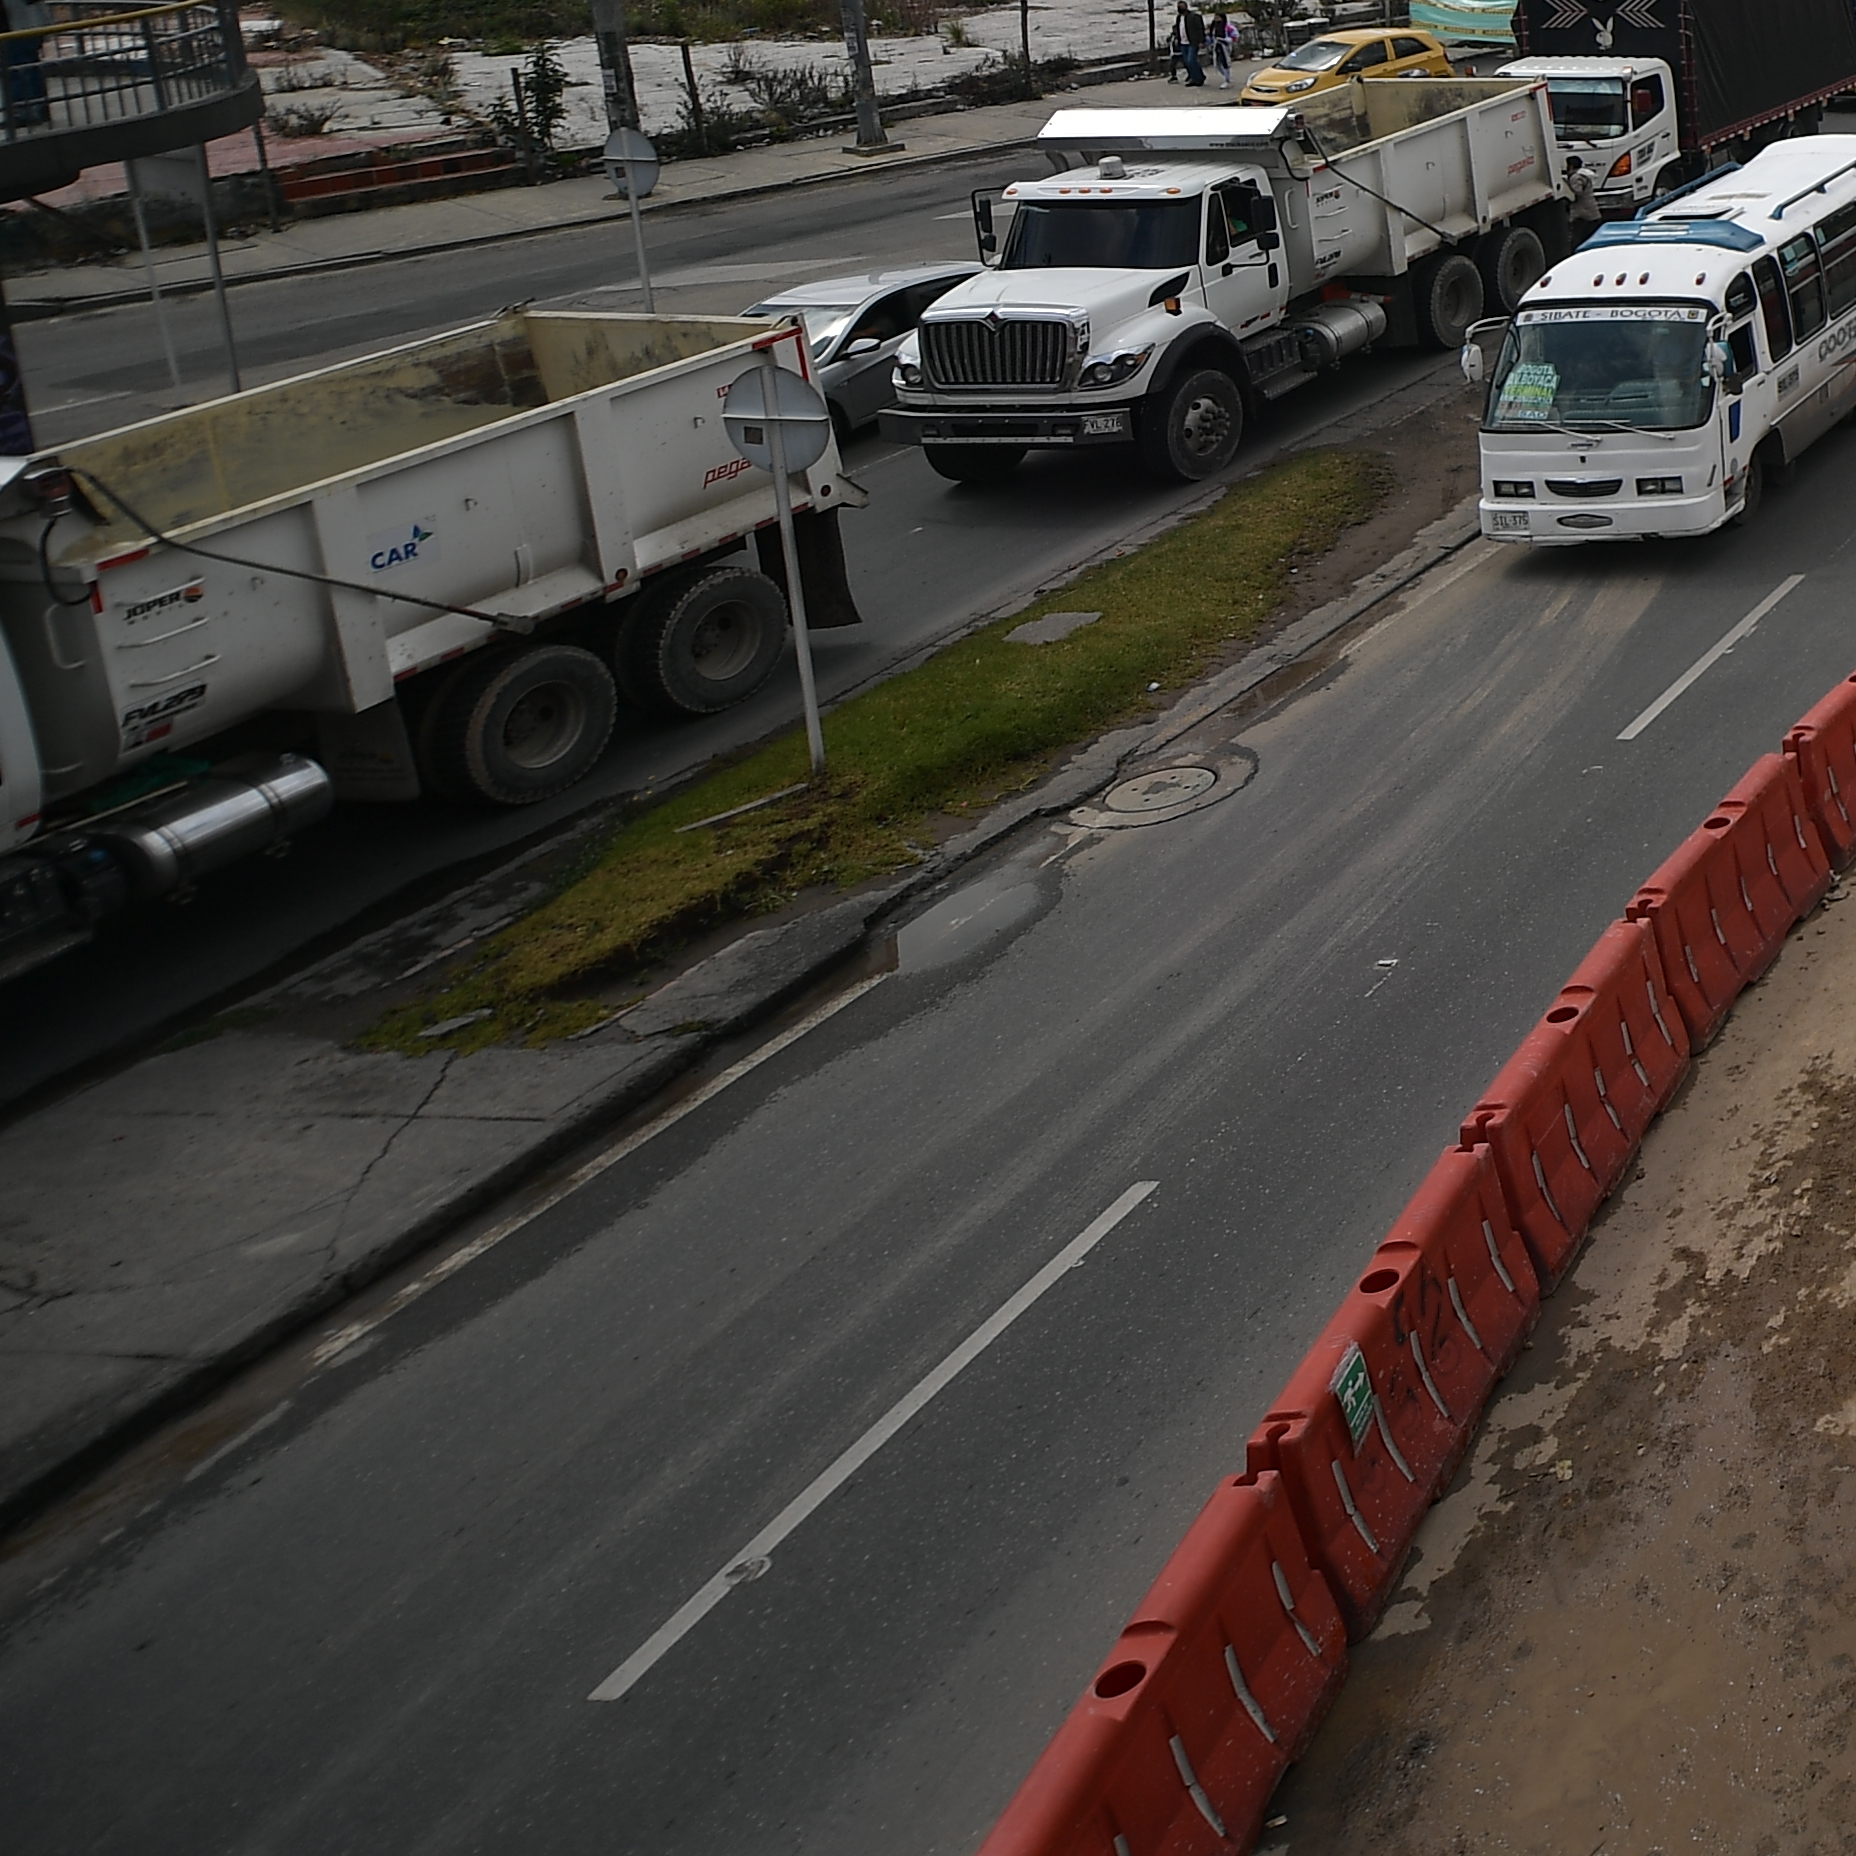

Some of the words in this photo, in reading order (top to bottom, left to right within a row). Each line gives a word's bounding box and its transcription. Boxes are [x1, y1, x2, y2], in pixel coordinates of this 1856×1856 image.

[1540, 309, 1591, 322] SIBATE
[1610, 308, 1684, 320] BOGOTA
[371, 542, 419, 570] CAR
[123, 590, 182, 622] JOPER
